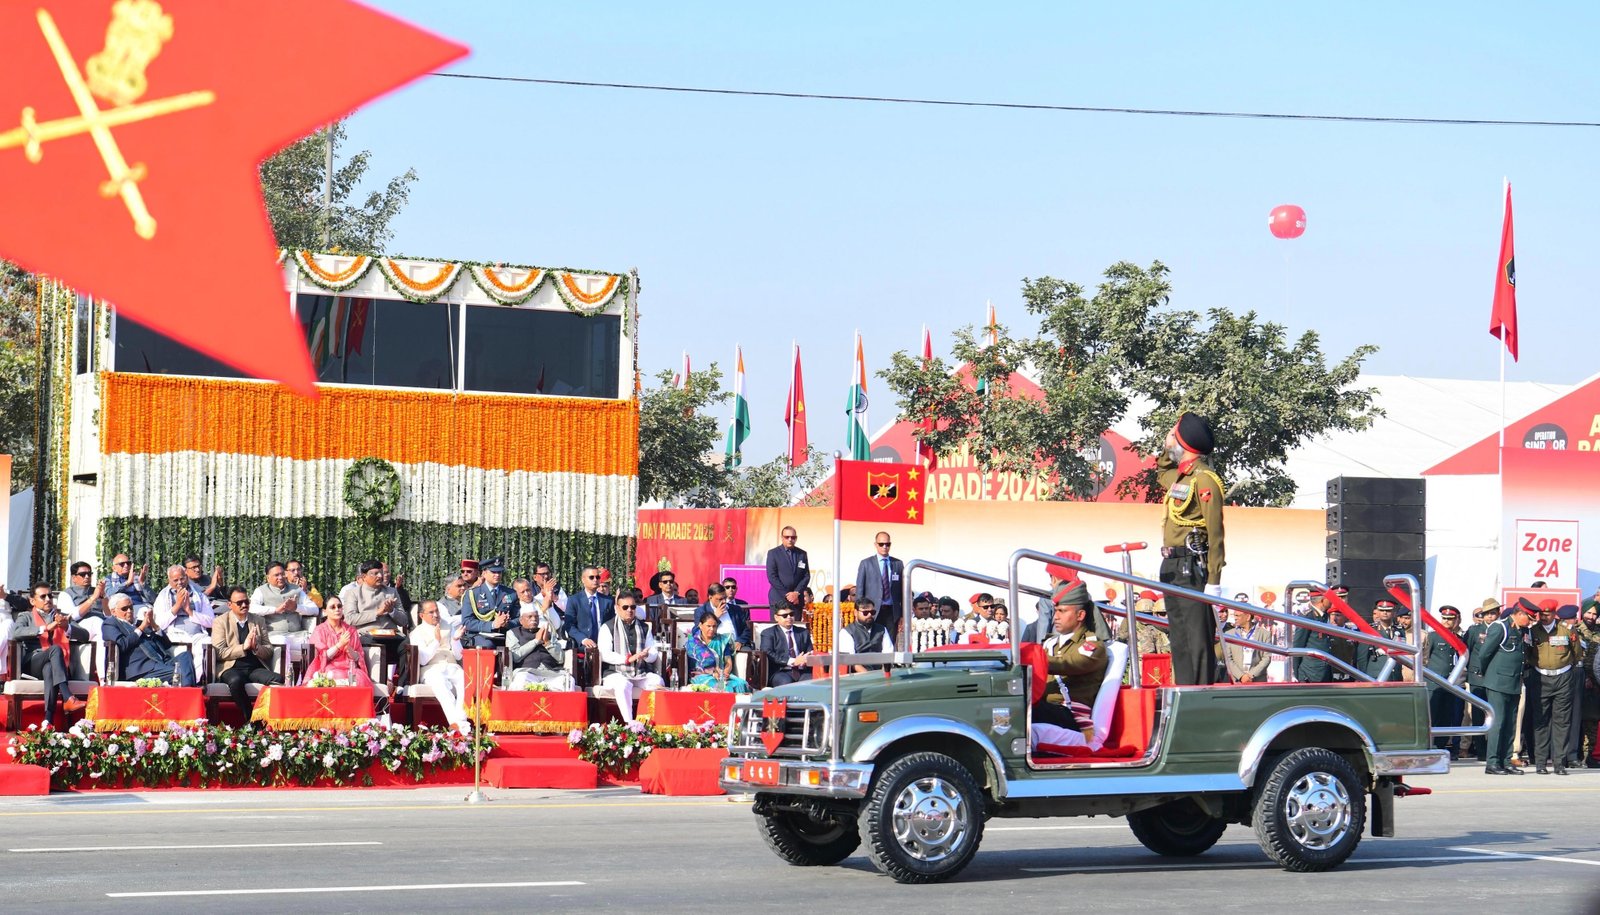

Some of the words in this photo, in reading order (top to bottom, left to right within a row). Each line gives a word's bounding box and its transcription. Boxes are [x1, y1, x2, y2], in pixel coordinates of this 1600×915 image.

[1524, 439, 1566, 450] SINDOR
[923, 472, 993, 503] ARADE
[642, 522, 658, 540] DAY
[660, 522, 692, 541] PARADE
[693, 523, 714, 541] 2026
[1522, 532, 1573, 553] Zone
[1534, 558, 1559, 578] 2A
